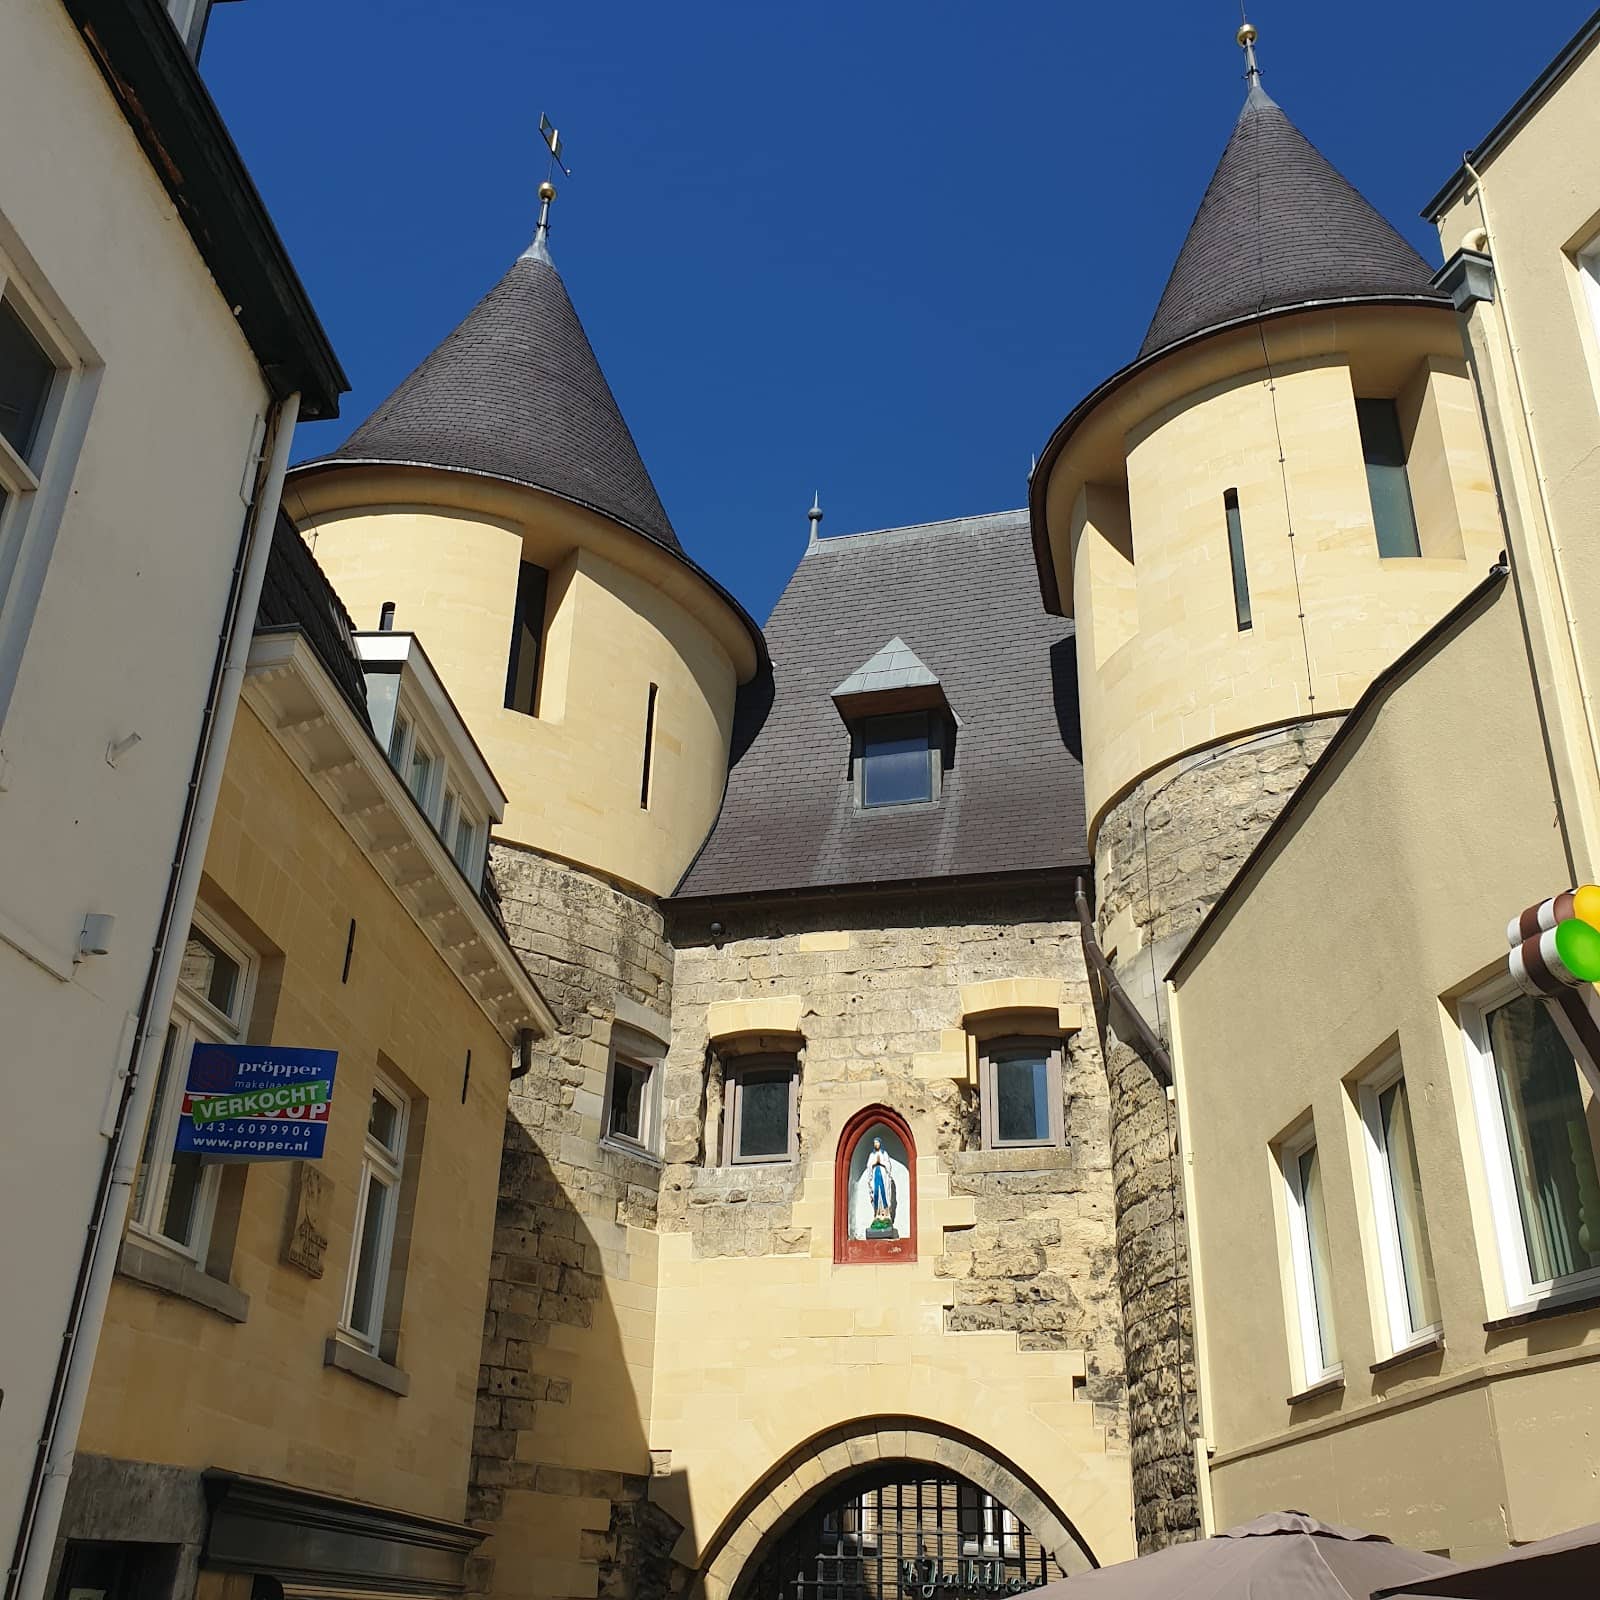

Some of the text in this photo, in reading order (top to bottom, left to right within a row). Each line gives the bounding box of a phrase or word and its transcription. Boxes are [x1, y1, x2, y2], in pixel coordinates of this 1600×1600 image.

[237, 1060, 322, 1078] pröpper
[199, 1085, 320, 1120] VERKOCHT
[194, 1121, 312, 1138] 043-6099906
[192, 1137, 309, 1153] www.propper.nl
